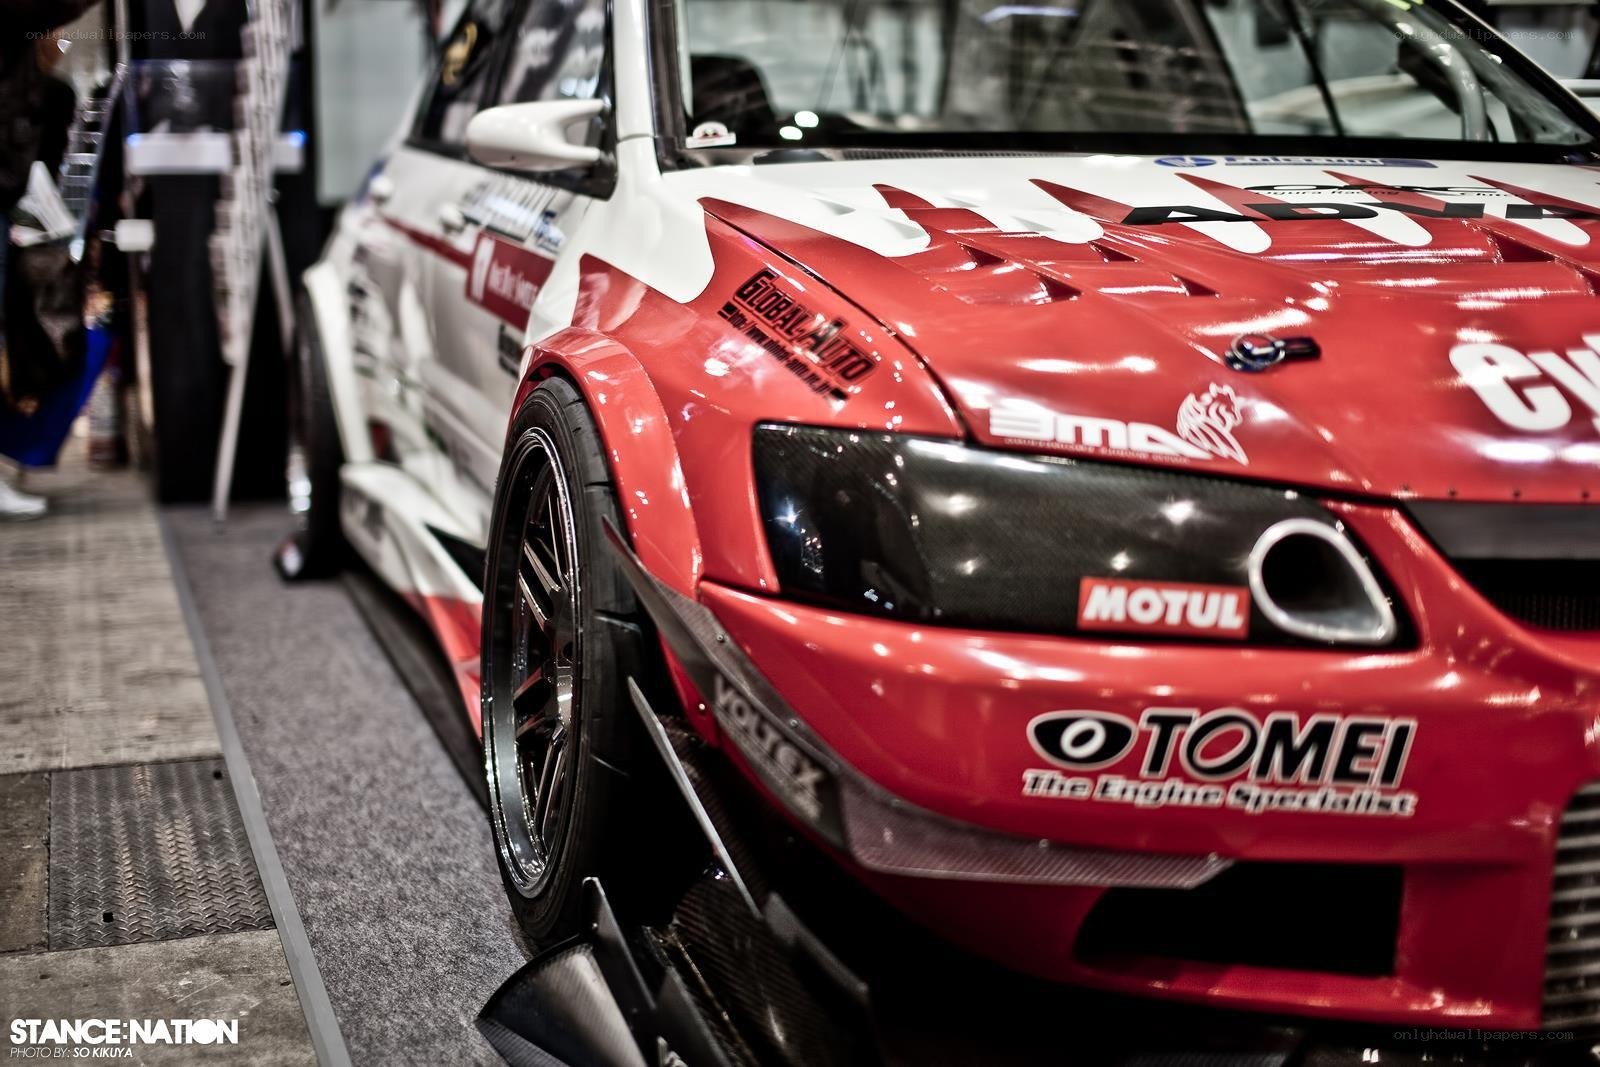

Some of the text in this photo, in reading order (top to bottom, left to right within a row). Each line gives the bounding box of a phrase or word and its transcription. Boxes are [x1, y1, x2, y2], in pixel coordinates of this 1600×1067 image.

[1082, 584, 1244, 629] MOTUL
[1022, 769, 1418, 817] The Engine Specialist
